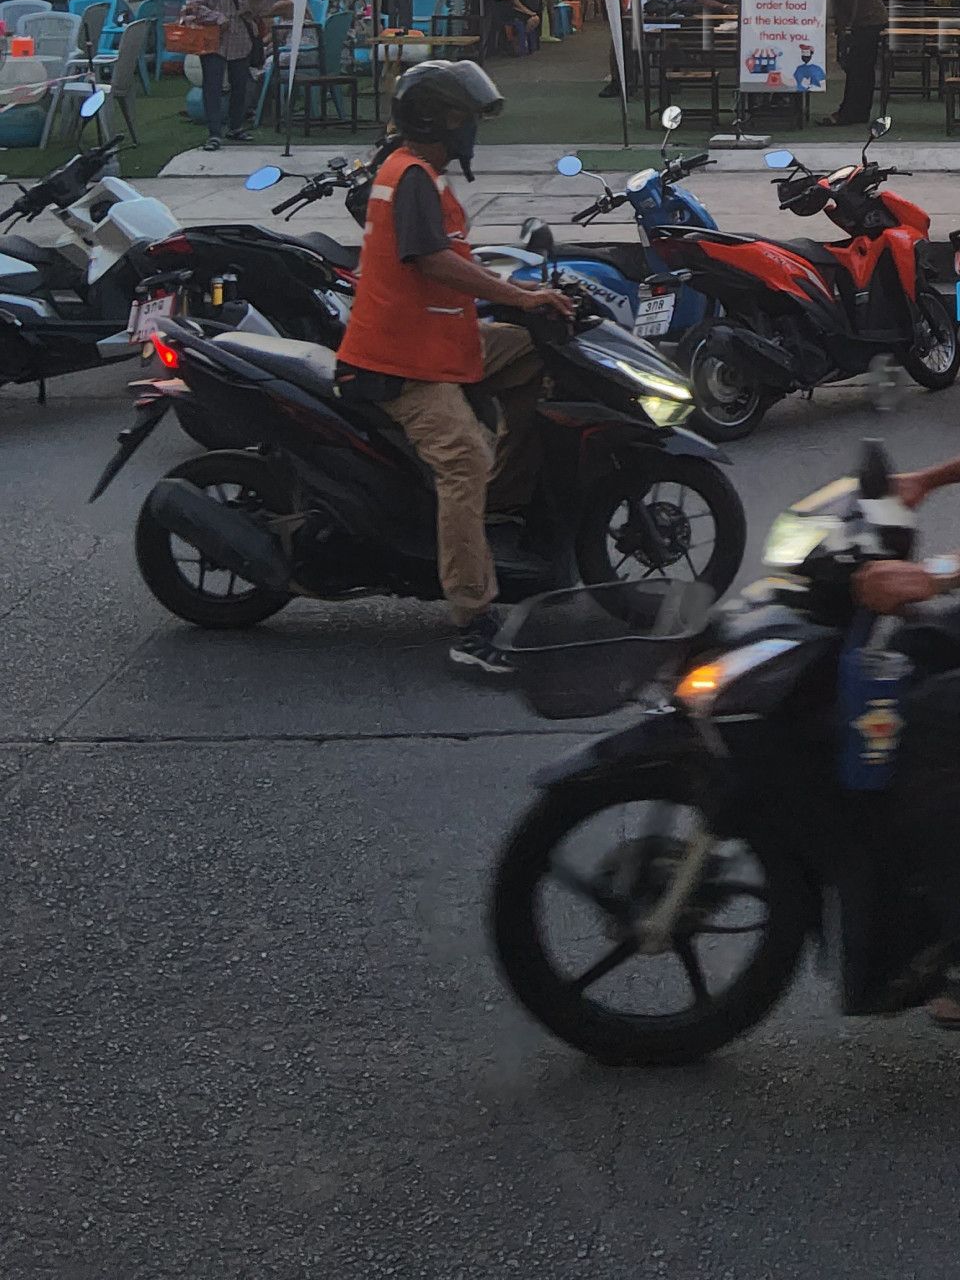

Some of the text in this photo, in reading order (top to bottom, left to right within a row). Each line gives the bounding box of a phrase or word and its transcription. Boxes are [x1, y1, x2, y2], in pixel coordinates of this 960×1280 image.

[756, 1, 807, 11] order food
[755, 15, 771, 24] the
[773, 15, 799, 24] kiosk
[759, 32, 810, 43] thank you.
